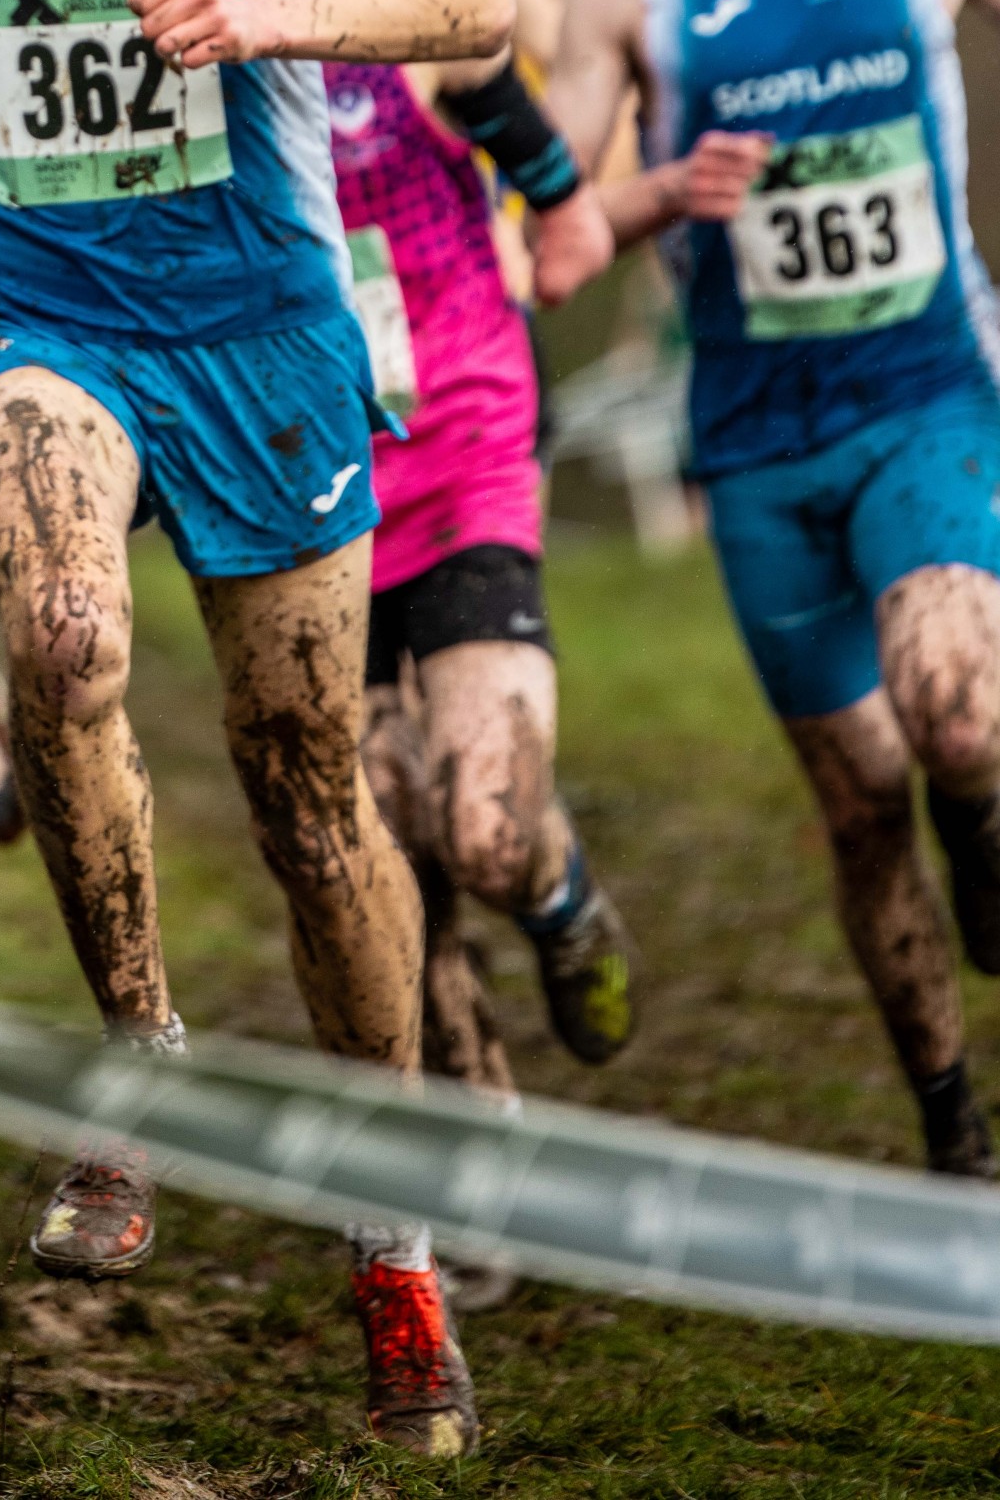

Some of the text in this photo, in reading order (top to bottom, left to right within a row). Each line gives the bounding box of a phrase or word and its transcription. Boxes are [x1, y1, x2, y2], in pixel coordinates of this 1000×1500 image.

[18, 36, 176, 141] 362
[712, 48, 910, 122] SCOTLAND
[769, 192, 898, 282] 363
